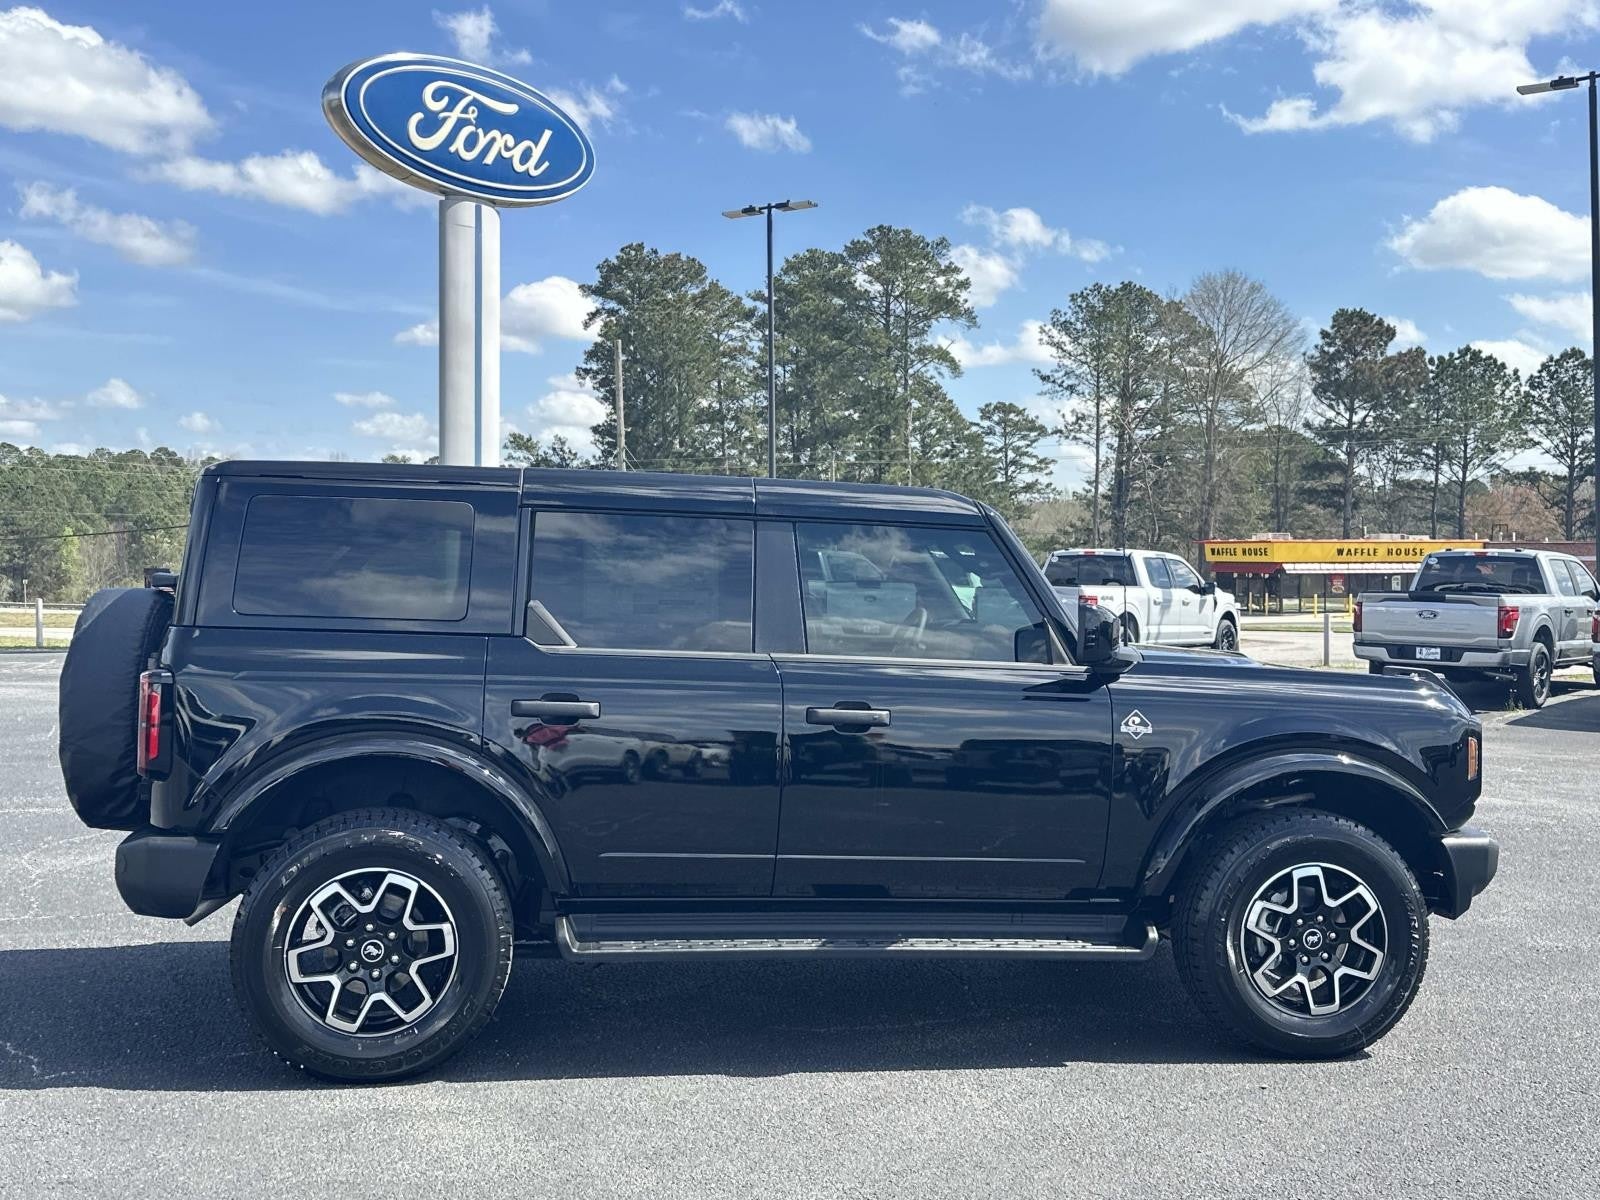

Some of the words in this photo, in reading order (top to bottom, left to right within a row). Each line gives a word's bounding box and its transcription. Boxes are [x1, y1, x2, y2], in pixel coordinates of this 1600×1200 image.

[407, 80, 552, 177] Ford
[1210, 547, 1238, 557] WAFFLE
[1241, 547, 1268, 557] HOUSE
[1336, 548, 1379, 557] WAFFLE
[1387, 547, 1425, 557] HOUSE
